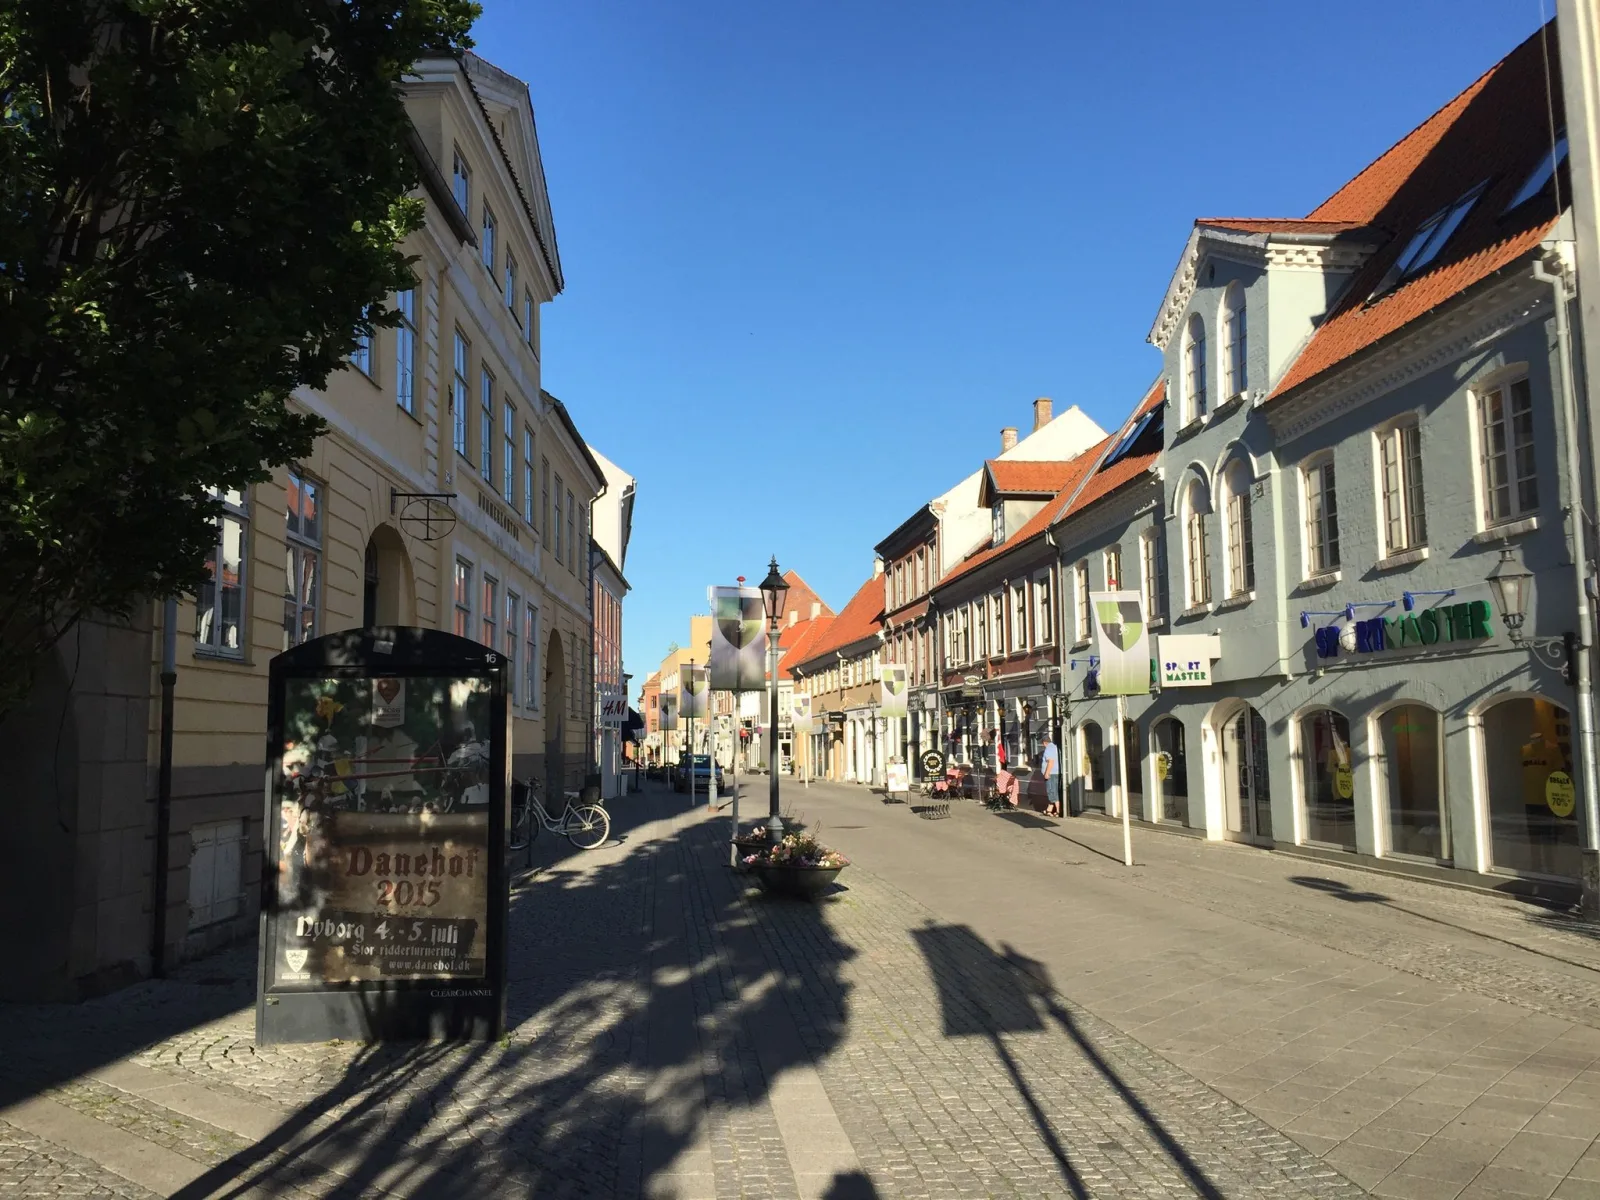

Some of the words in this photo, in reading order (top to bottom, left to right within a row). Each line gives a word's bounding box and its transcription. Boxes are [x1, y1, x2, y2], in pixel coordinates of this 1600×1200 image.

[485, 653, 496, 664] 16
[1166, 671, 1207, 681] MASTER
[345, 846, 479, 878] Danehof
[376, 880, 442, 907] 2015
[296, 915, 365, 943] Nyborg
[431, 924, 458, 945] juli
[352, 943, 375, 955] Stor
[380, 945, 457, 958] ridderturnering
[389, 960, 470, 972] www.danehof.dk
